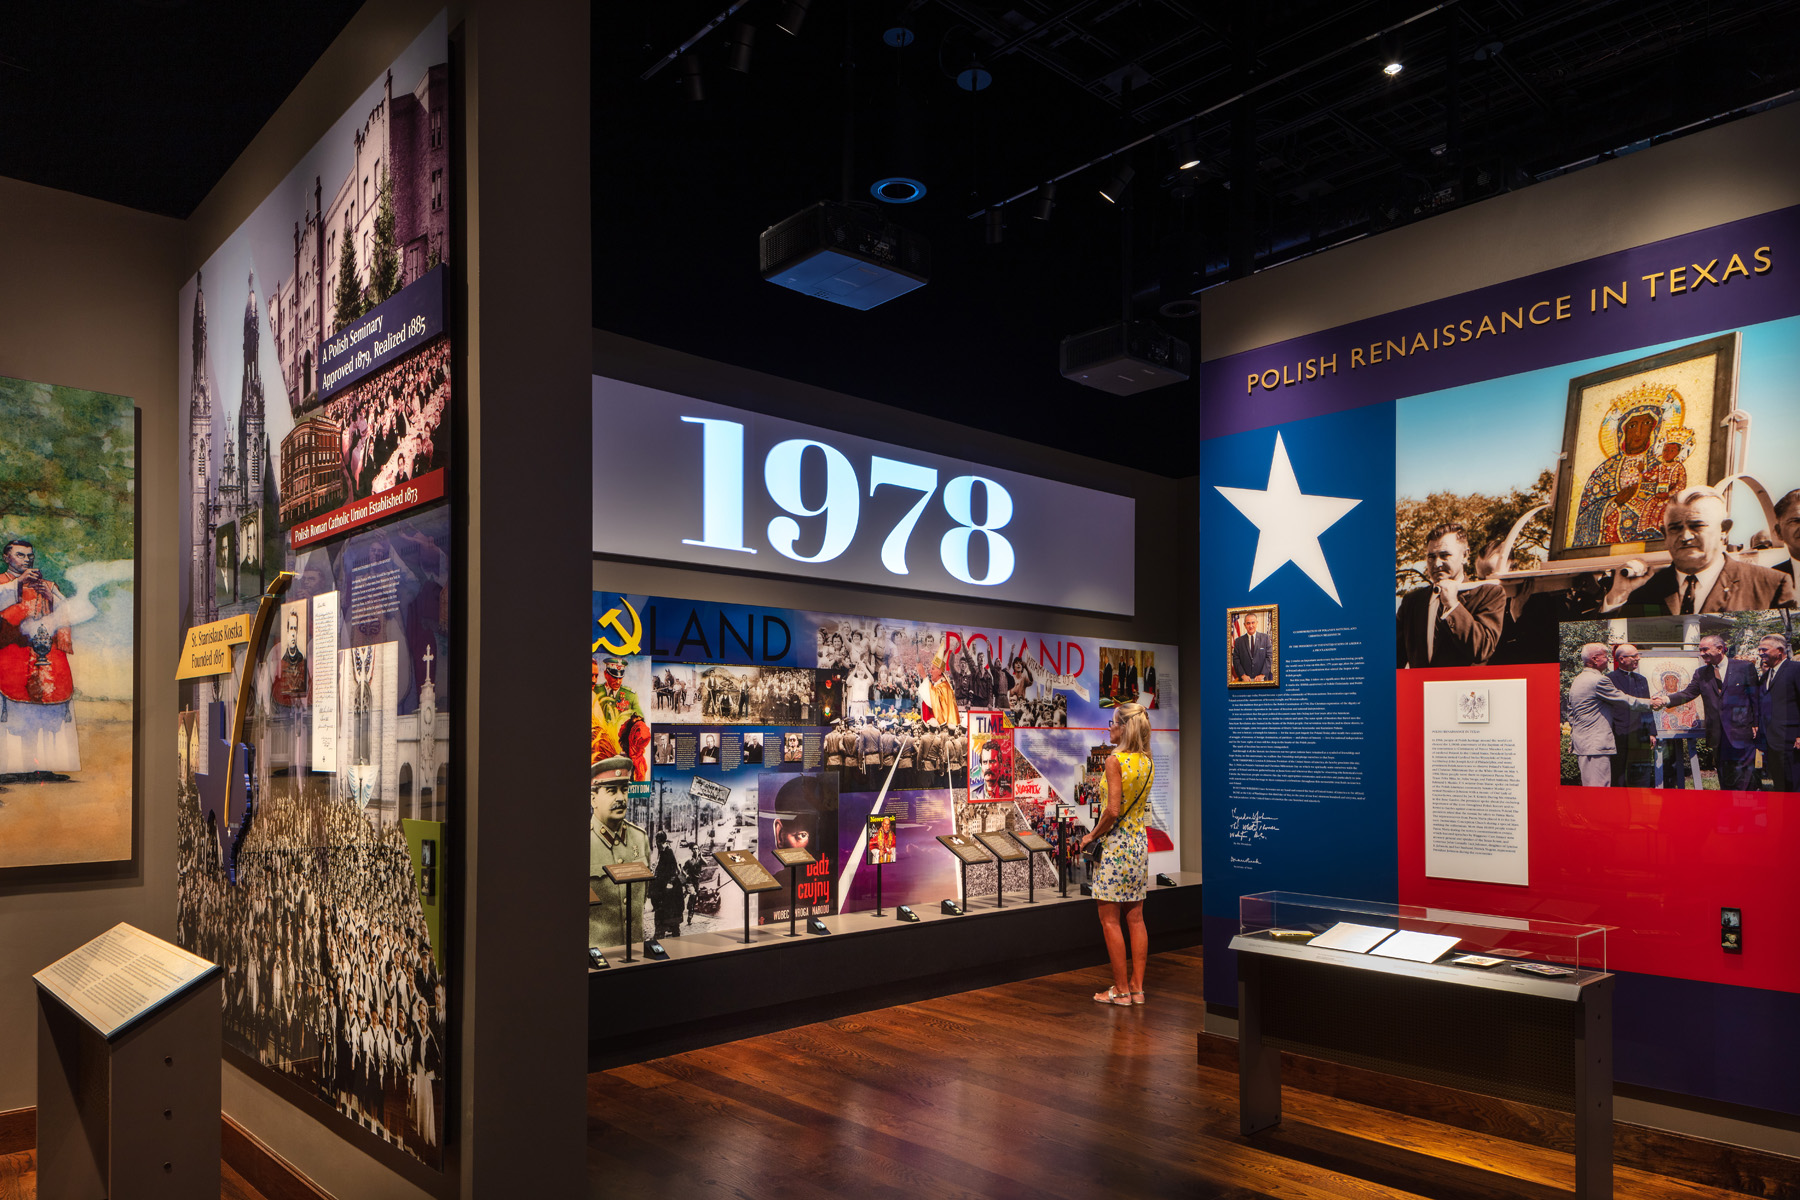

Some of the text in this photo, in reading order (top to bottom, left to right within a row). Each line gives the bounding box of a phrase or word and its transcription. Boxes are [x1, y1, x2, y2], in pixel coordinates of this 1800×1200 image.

[322, 314, 384, 365] A Polish Seminary
[1247, 245, 1773, 394] POLISH RENAISSANCE IN TEXAS
[322, 314, 427, 391] Approved 1879, Realized 1885
[294, 486, 419, 543] Polish Roman Catholic Union Established 1873
[681, 415, 1016, 586] 1978
[192, 648, 225, 669] Founded 1867
[199, 627, 224, 647] Stanislaus
[224, 622, 243, 641] Kostka
[649, 604, 793, 663] LAND
[976, 717, 1005, 734] TIME
[773, 909, 790, 921] WOBEC
[812, 904, 830, 916] NARODU
[797, 877, 830, 905] czujny
